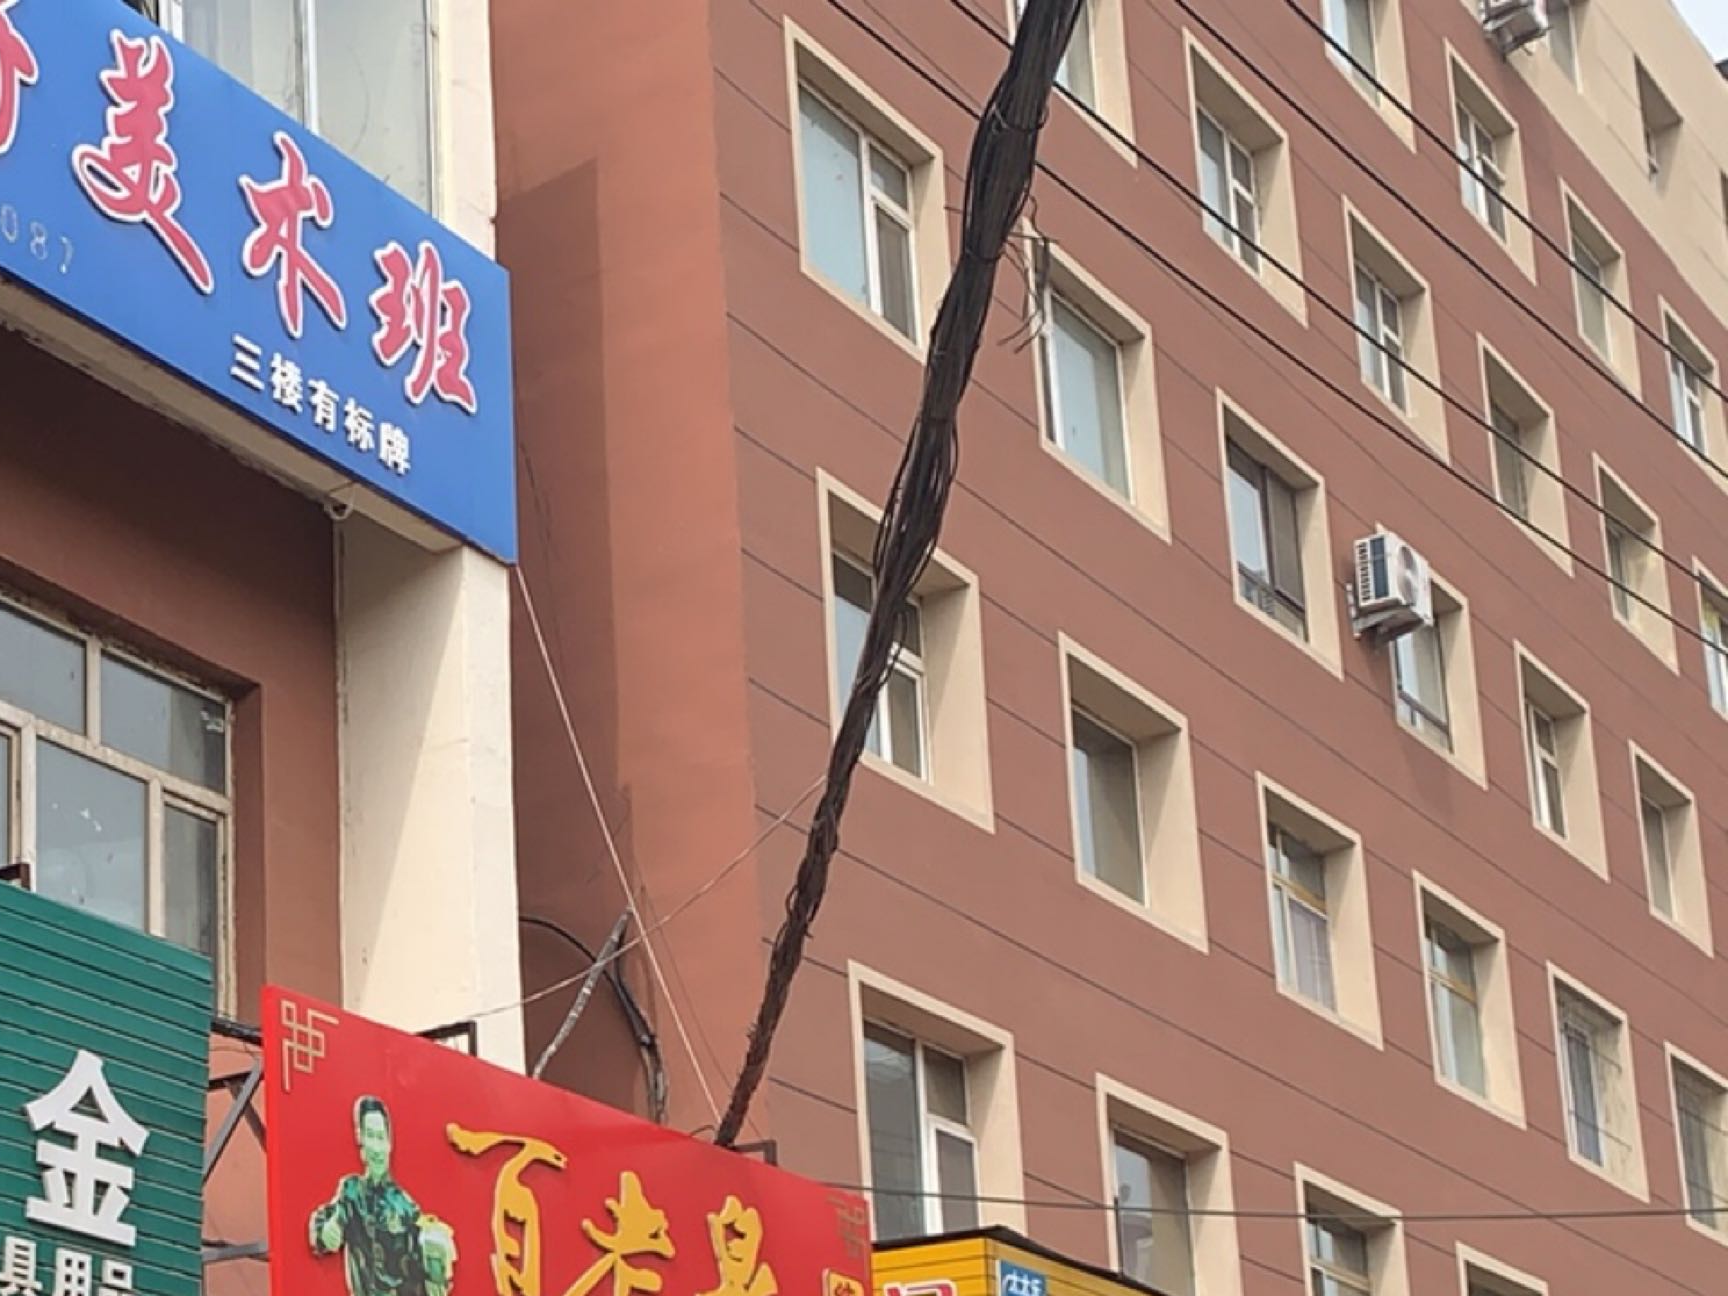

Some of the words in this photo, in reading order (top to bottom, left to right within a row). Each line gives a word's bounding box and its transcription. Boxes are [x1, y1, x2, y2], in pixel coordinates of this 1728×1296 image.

[229, 334, 411, 476] 三楼有标牌
